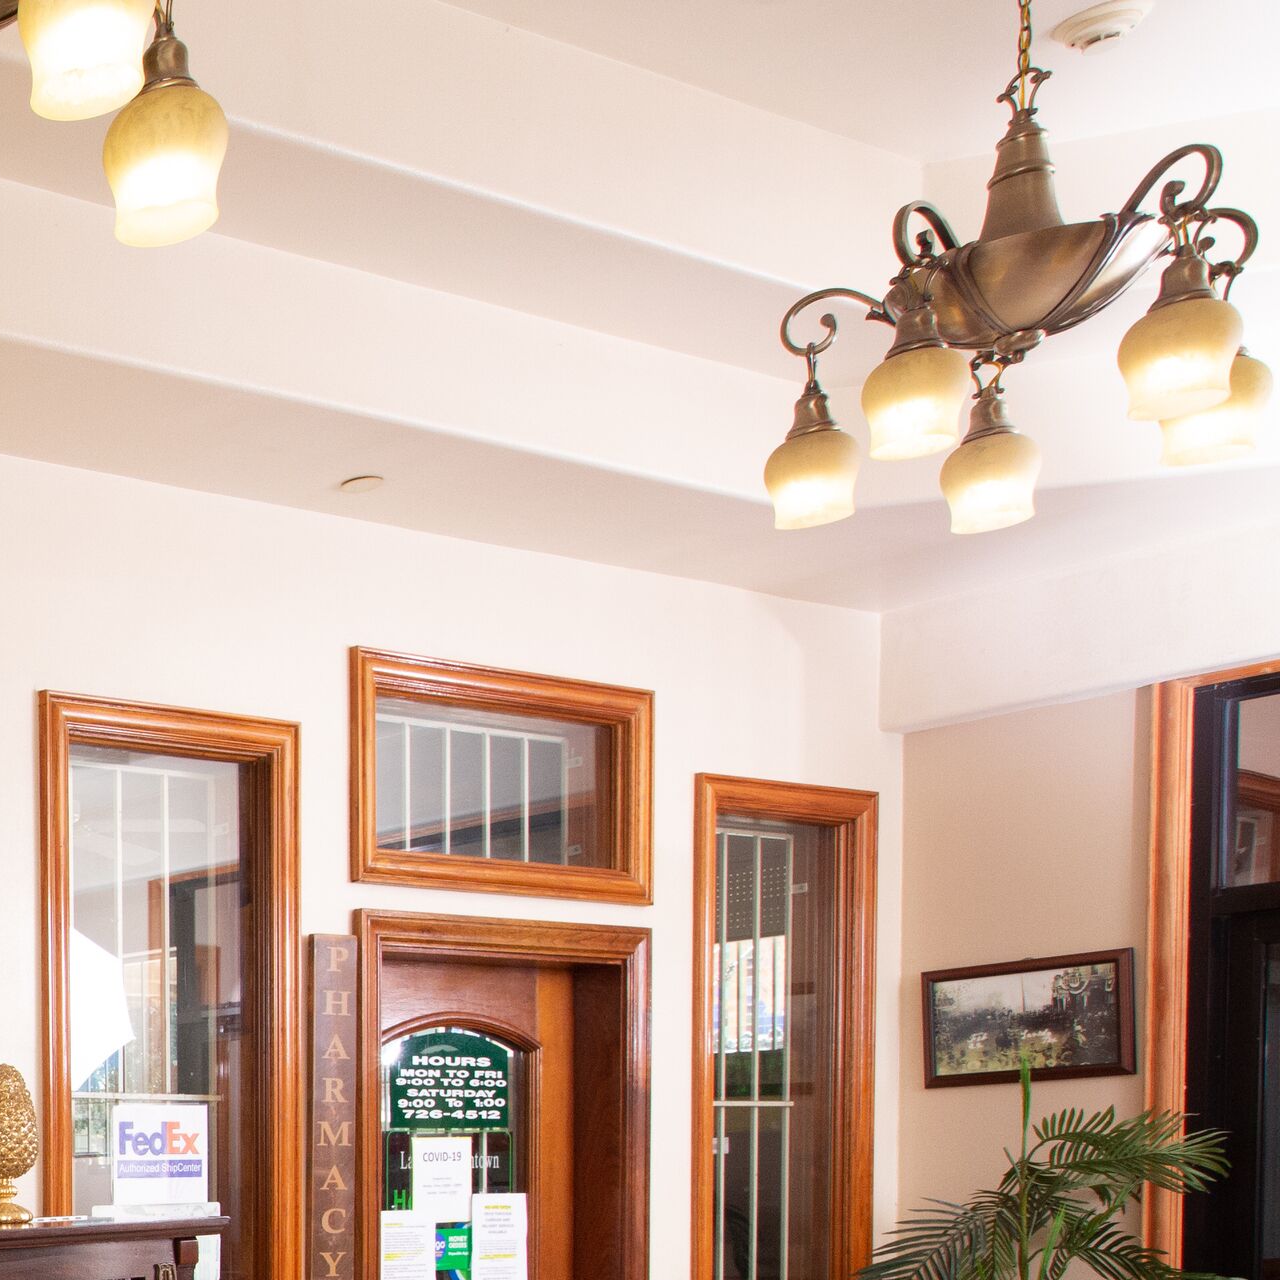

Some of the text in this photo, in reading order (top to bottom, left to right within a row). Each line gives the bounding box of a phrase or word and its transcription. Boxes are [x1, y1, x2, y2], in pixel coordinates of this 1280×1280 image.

[412, 1056, 491, 1067] HOURS
[400, 1069, 502, 1078] MON TO FRI
[396, 1078, 435, 1086] 9:00
[406, 1089, 496, 1098] SATURDAY
[398, 1098, 506, 1108] 9:00 To 1:00
[316, 946, 352, 1277] PHARMACY
[402, 1110, 501, 1119] 726-4512
[118, 1121, 200, 1156] FedEx
[422, 1152, 462, 1162] COVID-19
[120, 1162, 201, 1173] Authorized ShipCenter
